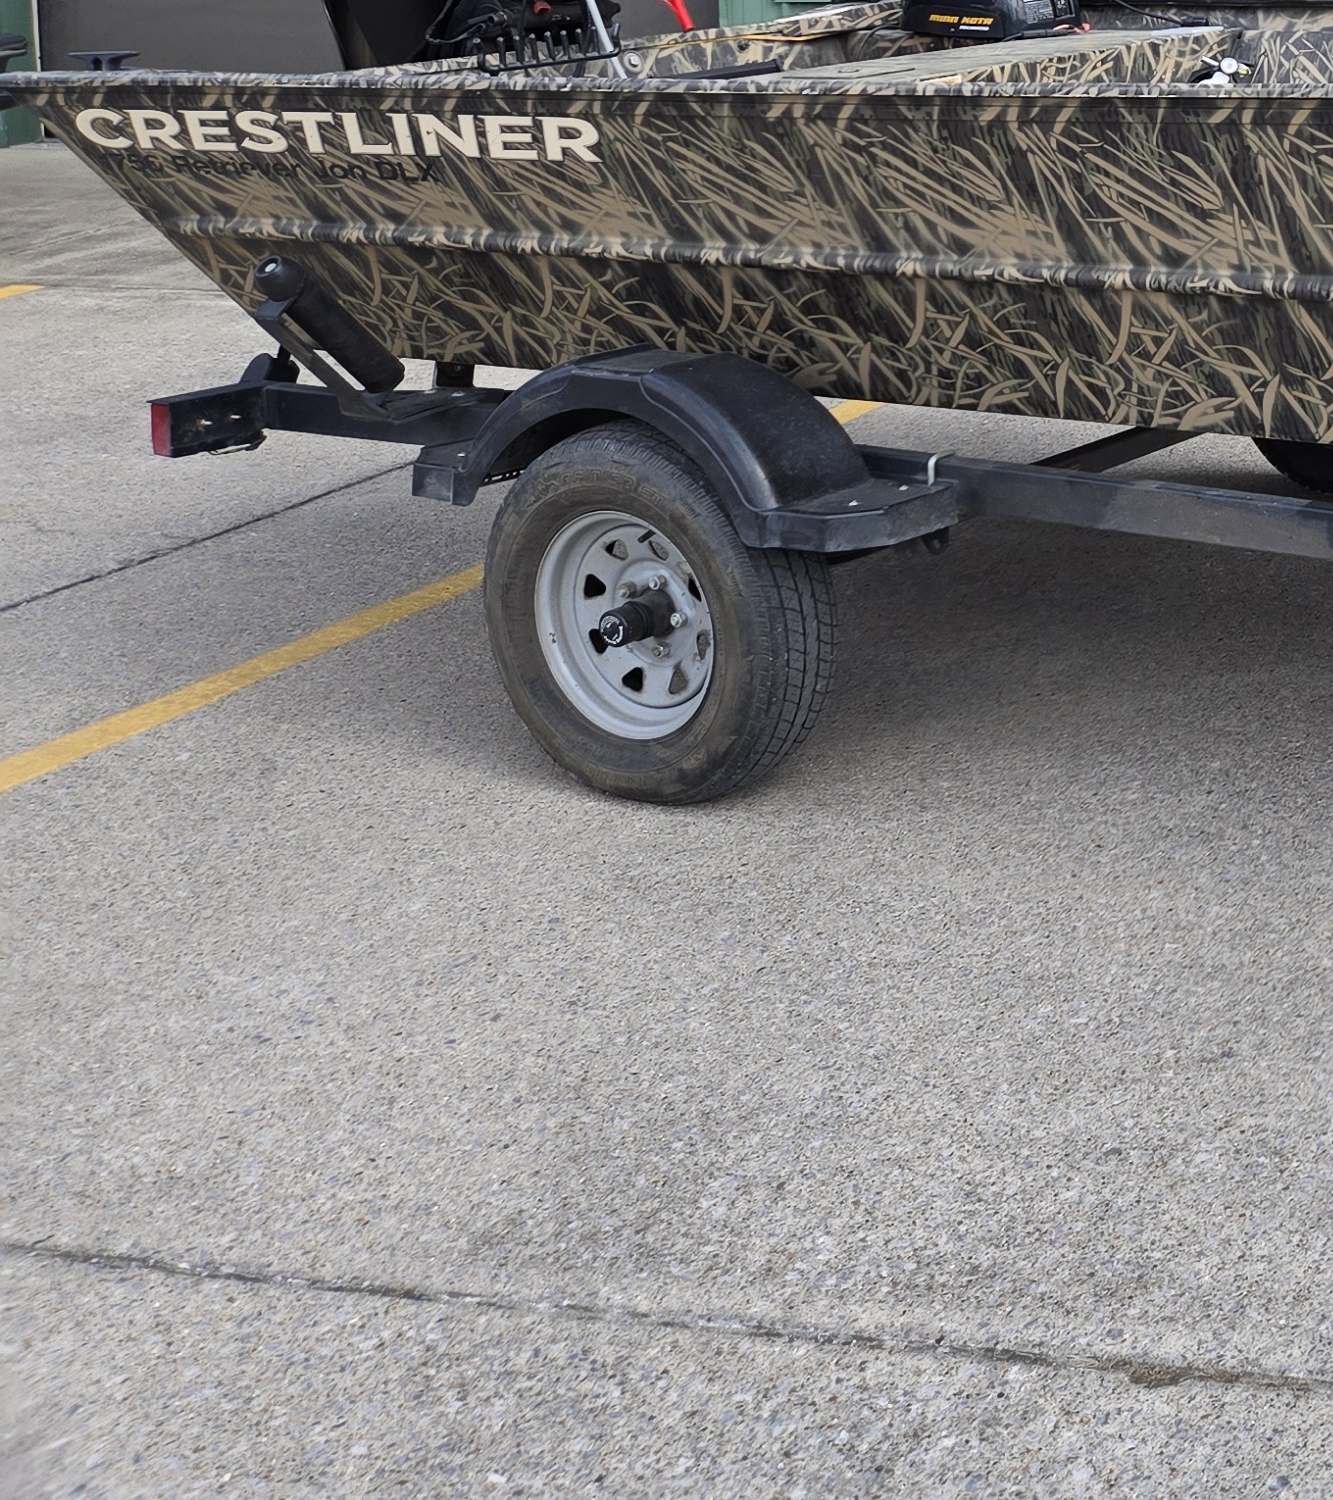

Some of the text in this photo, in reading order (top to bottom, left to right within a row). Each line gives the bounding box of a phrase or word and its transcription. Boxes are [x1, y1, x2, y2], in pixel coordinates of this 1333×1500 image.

[75, 107, 603, 164] CRESTLINER
[171, 153, 301, 179] Retriever
[313, 156, 370, 181] Jon
[378, 160, 439, 184] DLX
